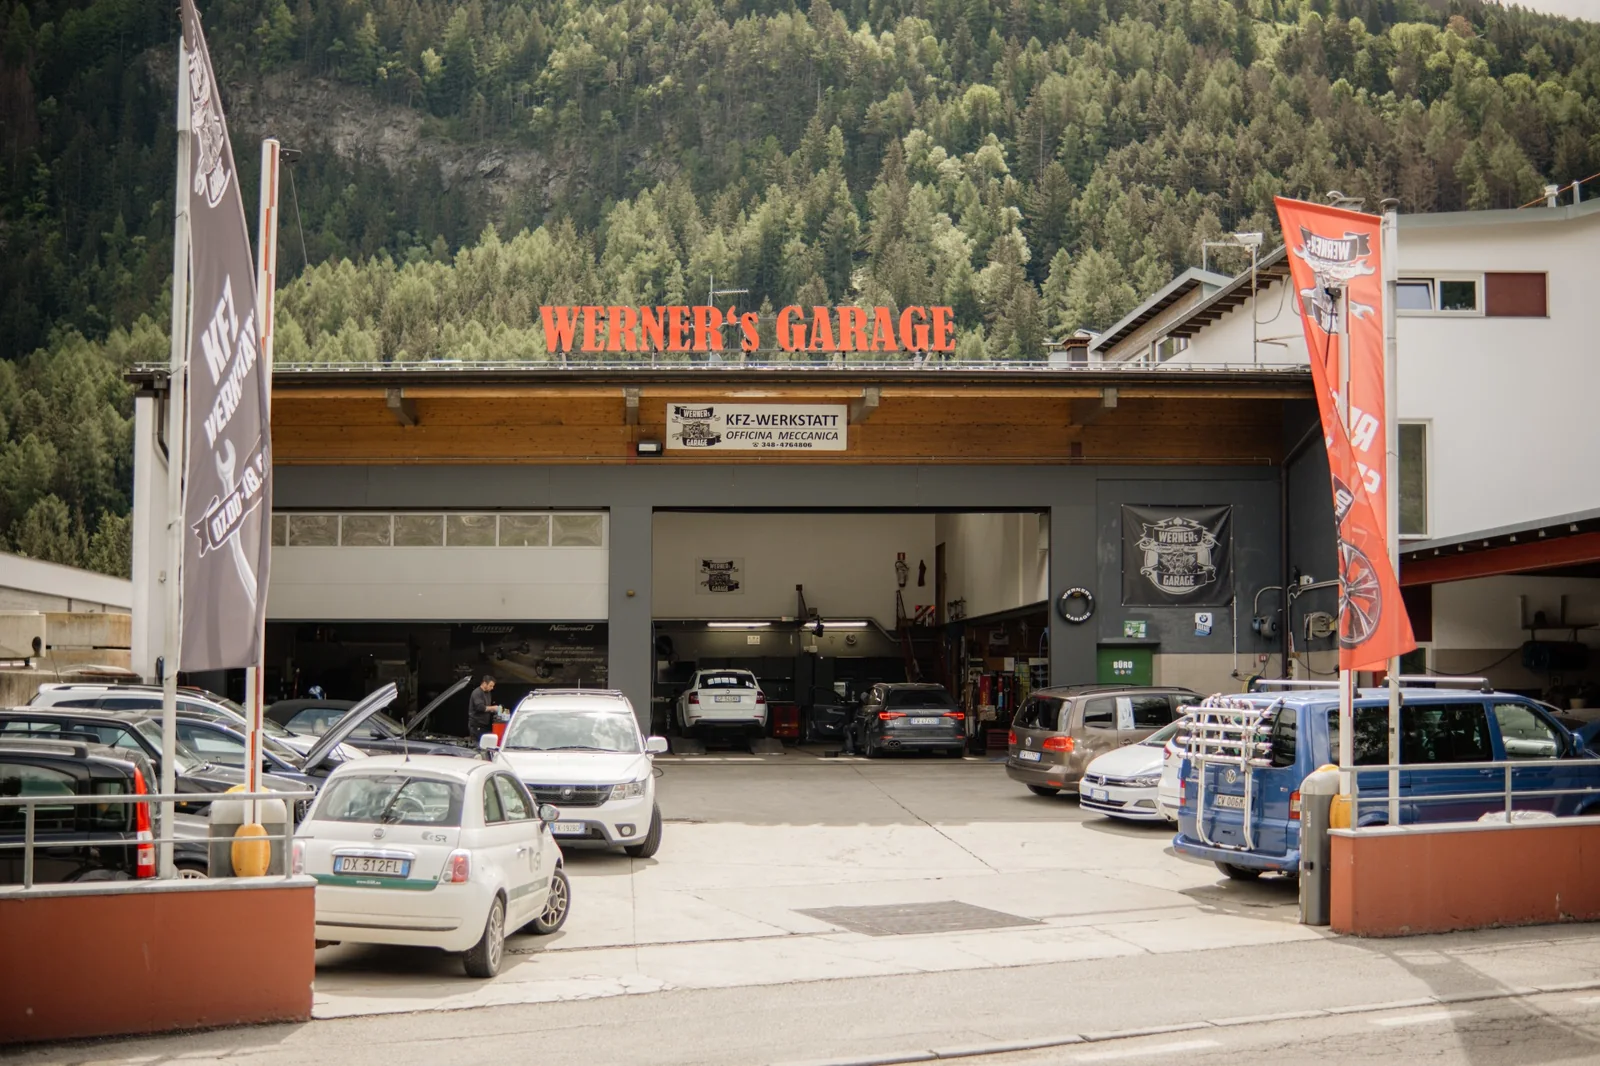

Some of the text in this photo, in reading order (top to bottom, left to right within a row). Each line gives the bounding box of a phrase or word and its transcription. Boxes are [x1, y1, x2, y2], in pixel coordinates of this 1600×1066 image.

[201, 273, 239, 386] KFZ
[775, 305, 956, 353] GARAGE
[726, 414, 839, 426] KFZ-WERKSTATT
[726, 431, 839, 440] OFFICINA MECCANICA
[685, 438, 708, 447] GARAGE
[1162, 575, 1195, 586] GARAGE
[1065, 611, 1092, 622] GARAGE
[1113, 660, 1133, 669] BÜRO
[343, 858, 400, 873] DX 312FL
